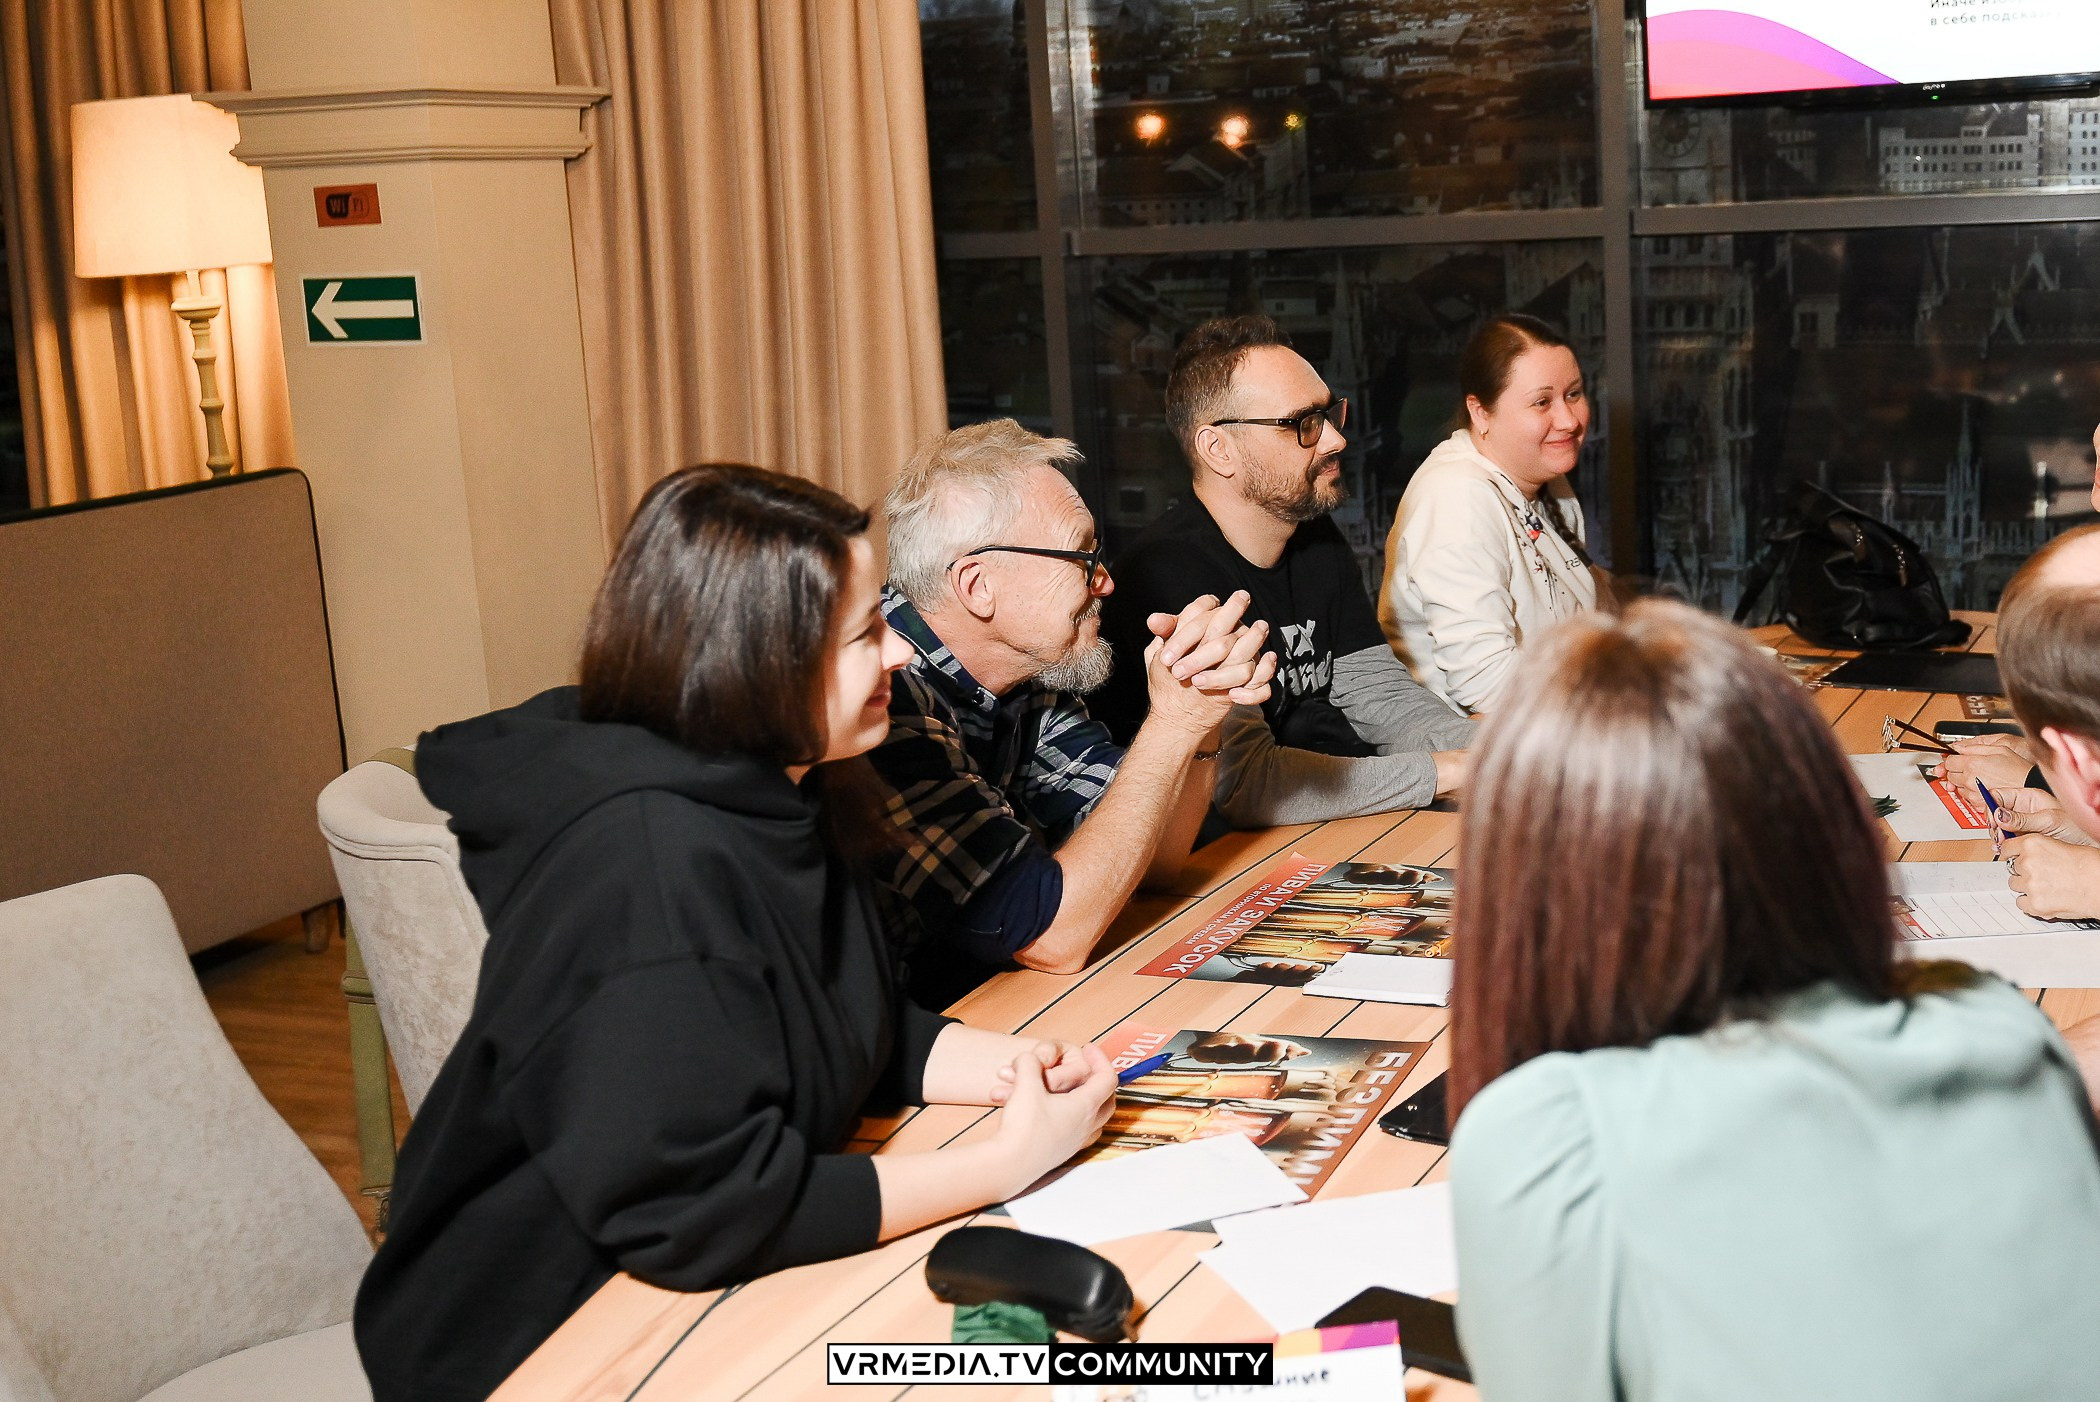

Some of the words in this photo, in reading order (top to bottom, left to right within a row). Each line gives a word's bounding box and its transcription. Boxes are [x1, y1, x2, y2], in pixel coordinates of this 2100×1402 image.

[1943, 12, 1977, 24] себе
[1266, 862, 1328, 894] ПИВА
[1162, 908, 1266, 973] ЗАКУСОК
[1110, 1031, 1168, 1069] ПИВ
